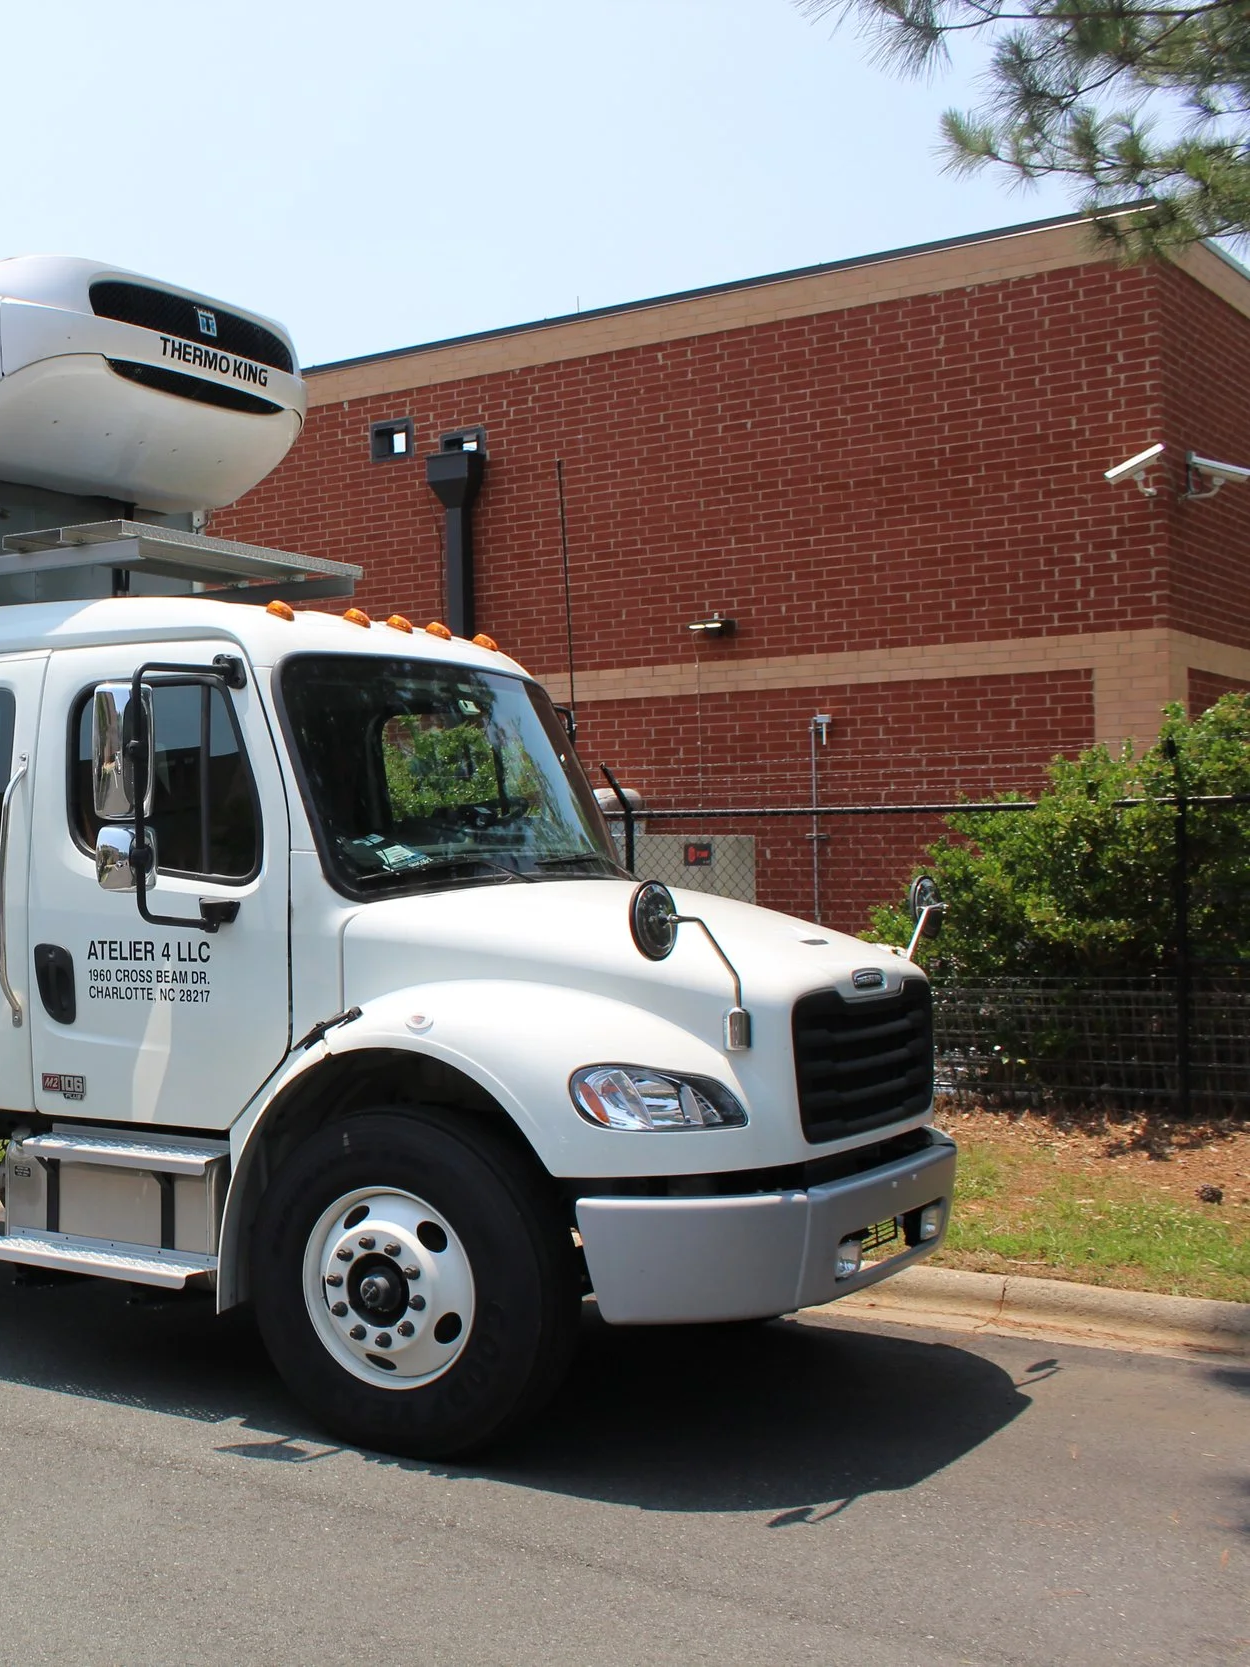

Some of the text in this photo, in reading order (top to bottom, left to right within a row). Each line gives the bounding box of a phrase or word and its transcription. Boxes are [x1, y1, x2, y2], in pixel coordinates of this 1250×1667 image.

[160, 337, 268, 387] THERMO KING
[87, 940, 211, 963] ATELIER 4 LLC
[88, 969, 210, 985] 1960 CROSS BEAM DR.
[89, 986, 210, 1003] CHARLOTTE, NC 28217
[45, 1075, 83, 1092] M2 106
